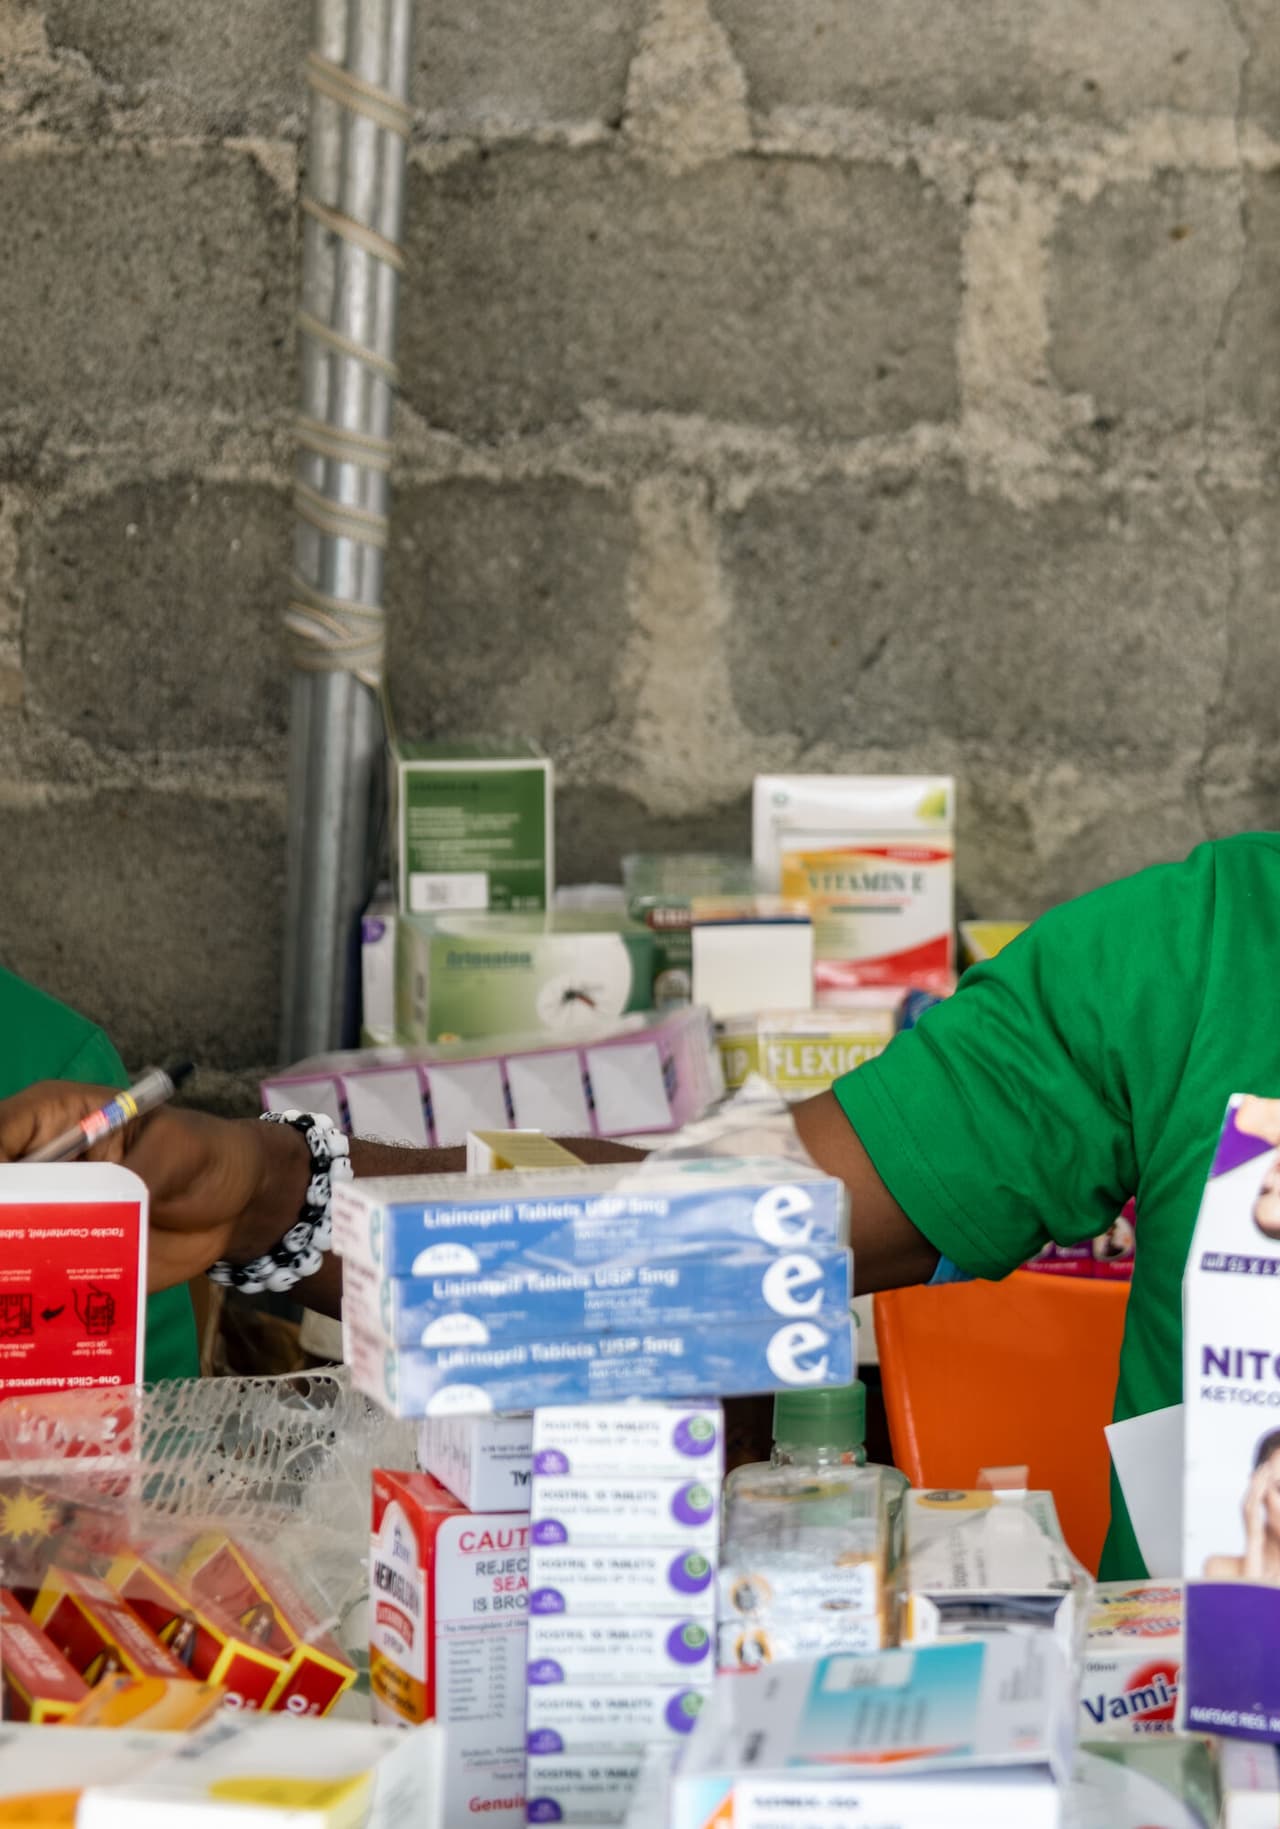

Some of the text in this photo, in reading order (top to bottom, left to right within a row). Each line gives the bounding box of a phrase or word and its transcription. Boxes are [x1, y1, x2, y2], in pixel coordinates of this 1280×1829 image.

[807, 873, 907, 892] VITAMIN
[423, 1206, 514, 1228] Lisinopril
[517, 1202, 581, 1221] Tablets
[91, 1227, 124, 1238] Tackle
[433, 1267, 680, 1299] Lisinopril Tablets USP 5mg
[436, 1348, 527, 1370] Lisinopril
[531, 1340, 595, 1360] Tablets
[641, 1335, 685, 1358] 5mg
[9, 1375, 122, 1388] One-Click Assurance:
[472, 1597, 489, 1613] IS
